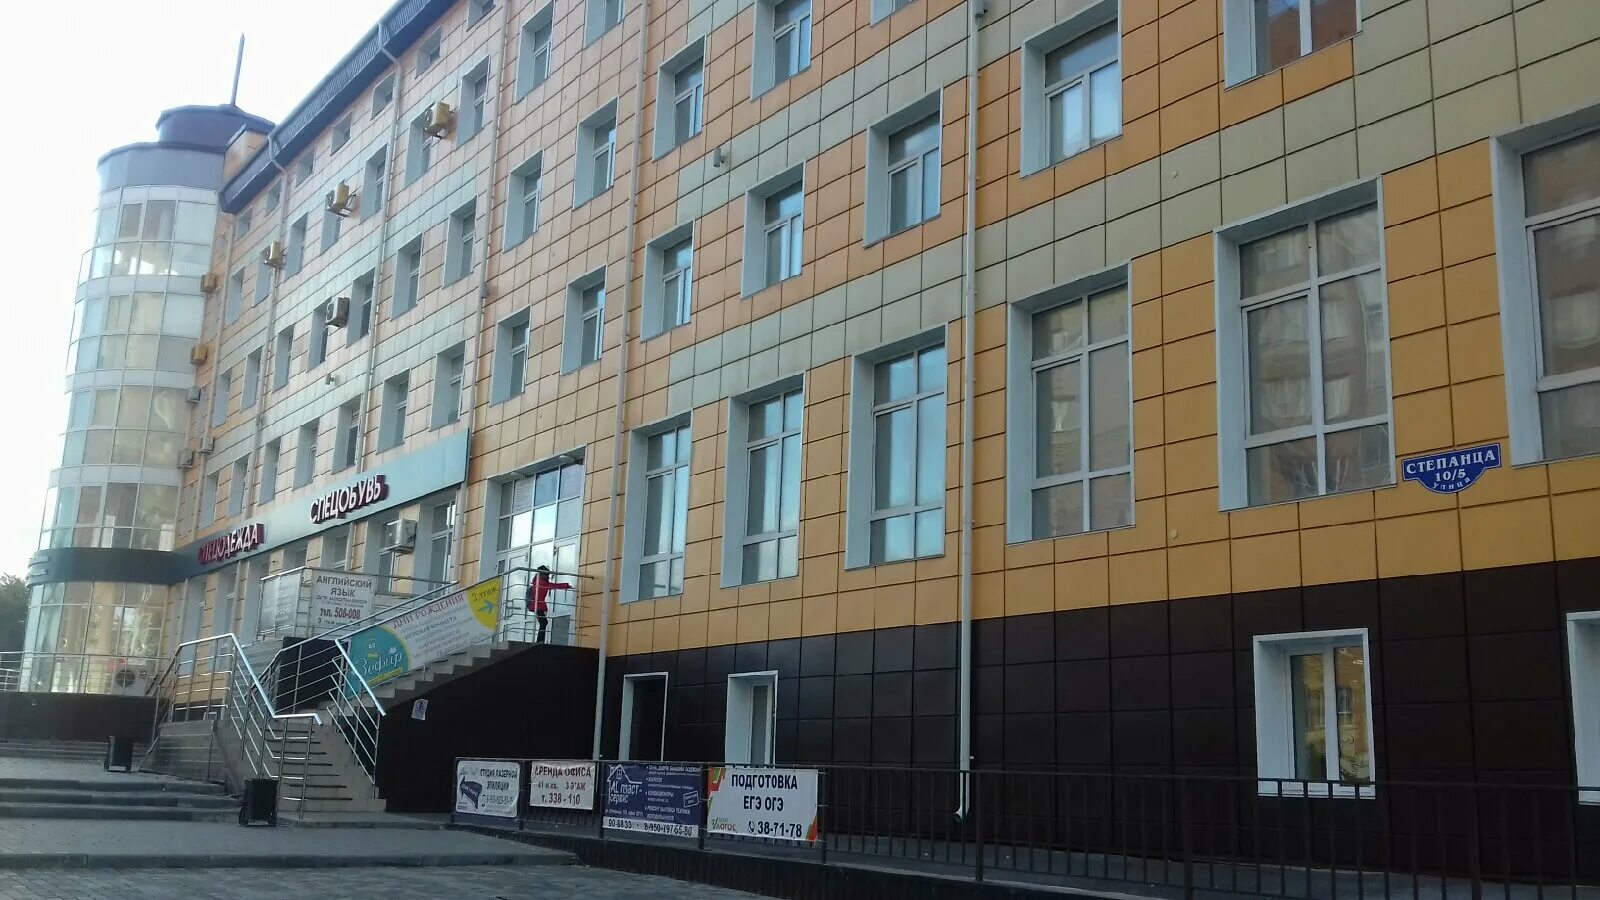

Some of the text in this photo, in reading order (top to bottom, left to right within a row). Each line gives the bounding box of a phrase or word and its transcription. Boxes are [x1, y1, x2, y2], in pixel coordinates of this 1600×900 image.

[1406, 449, 1496, 474] СТЕПАНЦА
[1435, 468, 1467, 482] 10/5
[309, 474, 388, 524] СПЕЦОБУВЬ
[316, 575, 372, 589] АНГЛИЙСКИЙ
[330, 587, 356, 598] ЯЗЫК
[393, 615, 415, 630] ДНИ
[415, 594, 465, 619] РОЖДЕНИЯ
[355, 652, 403, 677] Зефир
[564, 766, 592, 778] ОФИСА
[731, 773, 799, 791] ПОДГОТОВКА
[743, 795, 784, 812] ЕГЭ ОГЭ
[757, 821, 802, 838] 38-71-78
